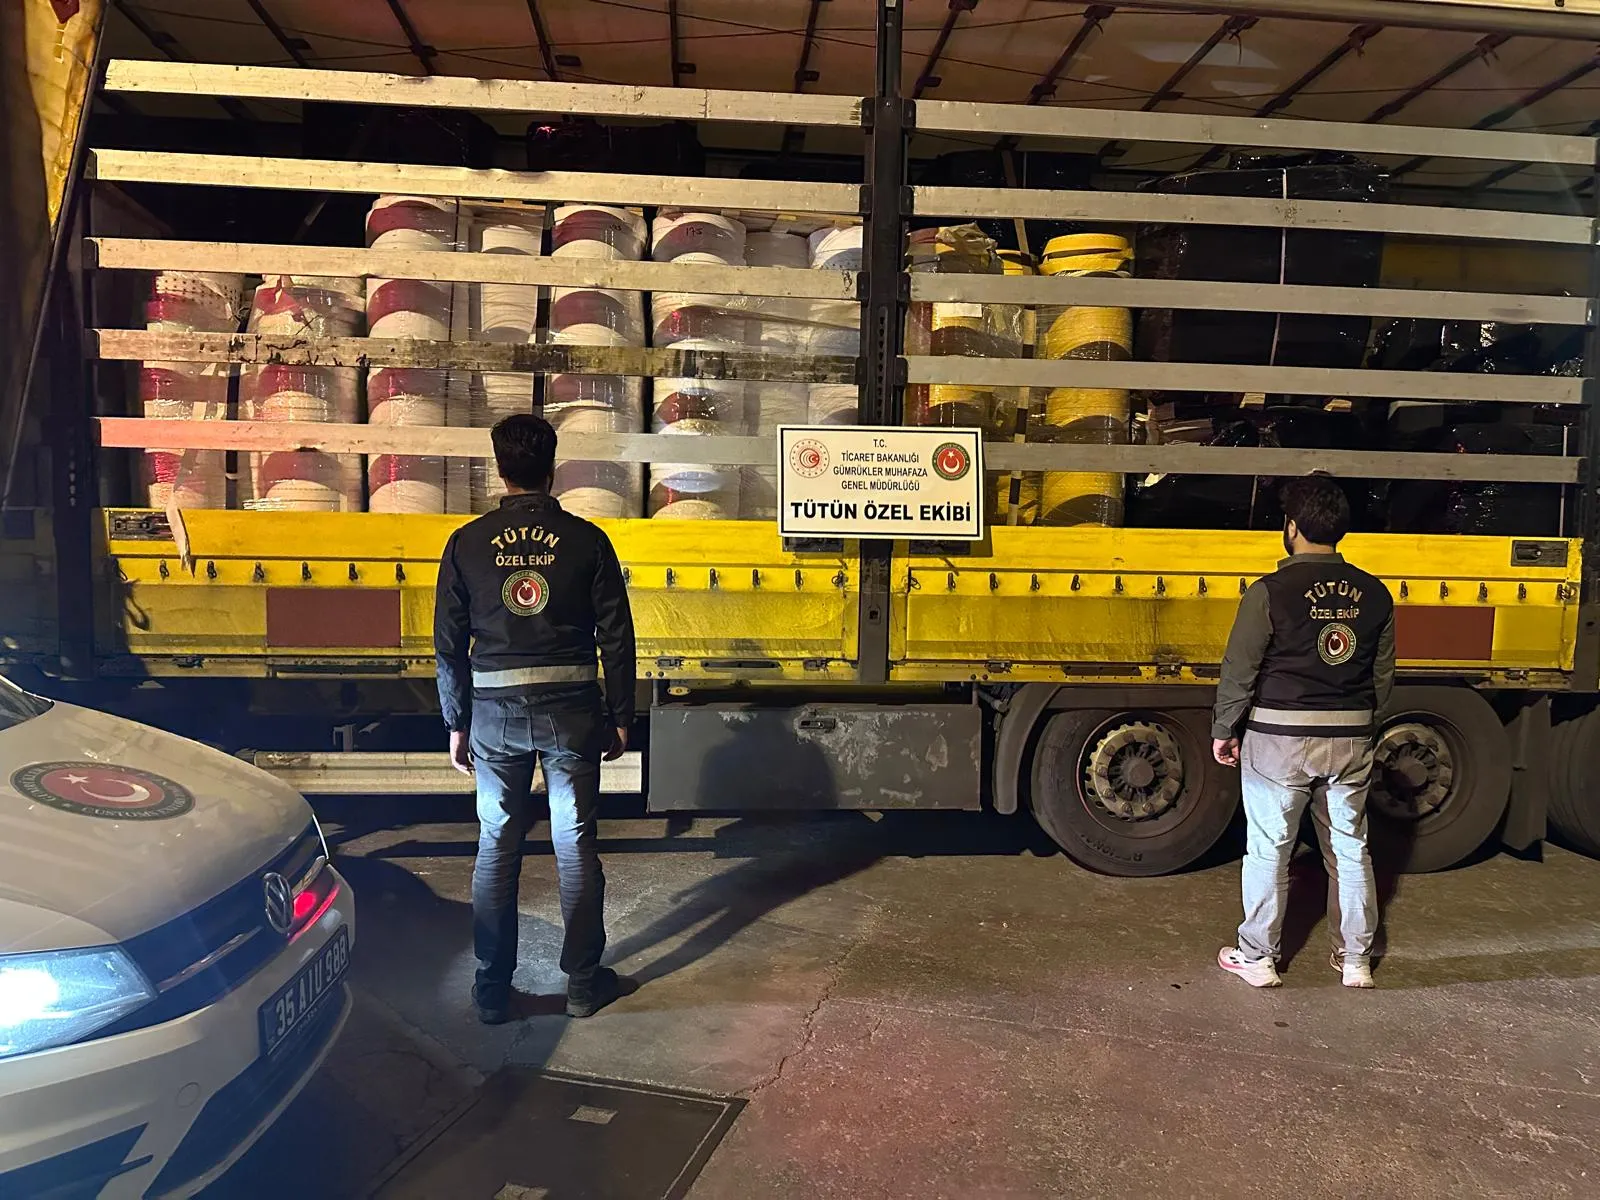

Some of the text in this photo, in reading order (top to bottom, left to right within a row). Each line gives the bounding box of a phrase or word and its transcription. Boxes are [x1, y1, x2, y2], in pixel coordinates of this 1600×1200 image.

[873, 439, 887, 448] T.C.
[841, 452, 919, 463] TİCARET BAKANLIĞI
[833, 465, 928, 477] GÜMRÜKLER MUHAFAZA
[841, 479, 920, 491] GENEL MÜDÜRLÜĞÜ
[791, 499, 971, 522] TÜTÜN ÖZEL EKİBİ
[490, 526, 560, 550] TÜTÜN
[495, 551, 555, 567] ÖZEL EKİP
[1304, 580, 1362, 604] TÜTÜN
[1309, 605, 1360, 619] ÖZEL EKİP
[276, 988, 295, 1036] 35
[325, 934, 346, 982] 988
